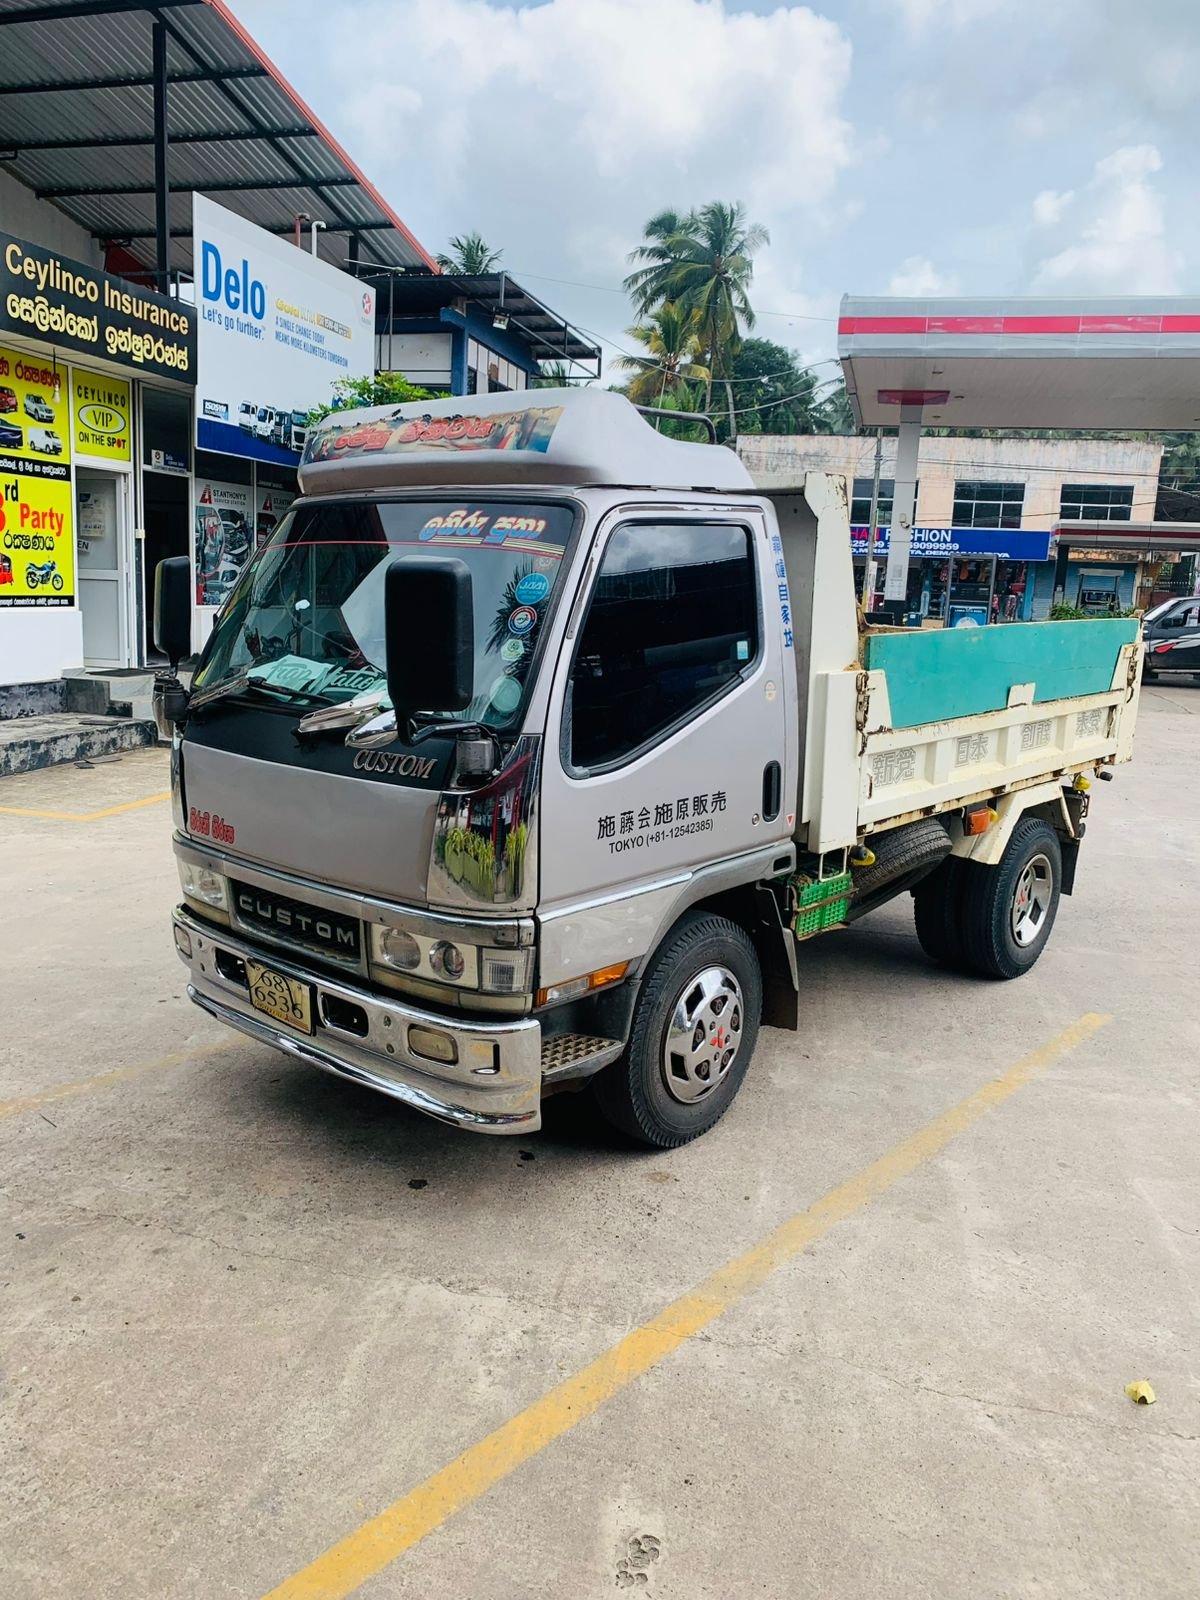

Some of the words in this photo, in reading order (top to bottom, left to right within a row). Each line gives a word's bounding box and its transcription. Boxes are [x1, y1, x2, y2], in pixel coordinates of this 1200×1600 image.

[5, 243, 99, 303] Ceylinco
[104, 279, 189, 335] Insurance
[202, 239, 265, 320] Delo
[202, 304, 223, 326] Let's
[224, 315, 235, 331] go
[77, 385, 126, 408] CEYLINCO
[92, 410, 113, 428] VIP
[78, 431, 90, 443] ON
[91, 433, 105, 446] THE
[106, 436, 127, 449] SPOT
[20, 503, 64, 537] Party
[885, 528, 952, 543] FSHION
[353, 749, 438, 779] CUSTOM
[609, 835, 644, 854] TOKYO
[646, 819, 713, 847] (+81-12542385)
[239, 894, 355, 947] CUSTOM
[254, 985, 304, 1020] 6536
